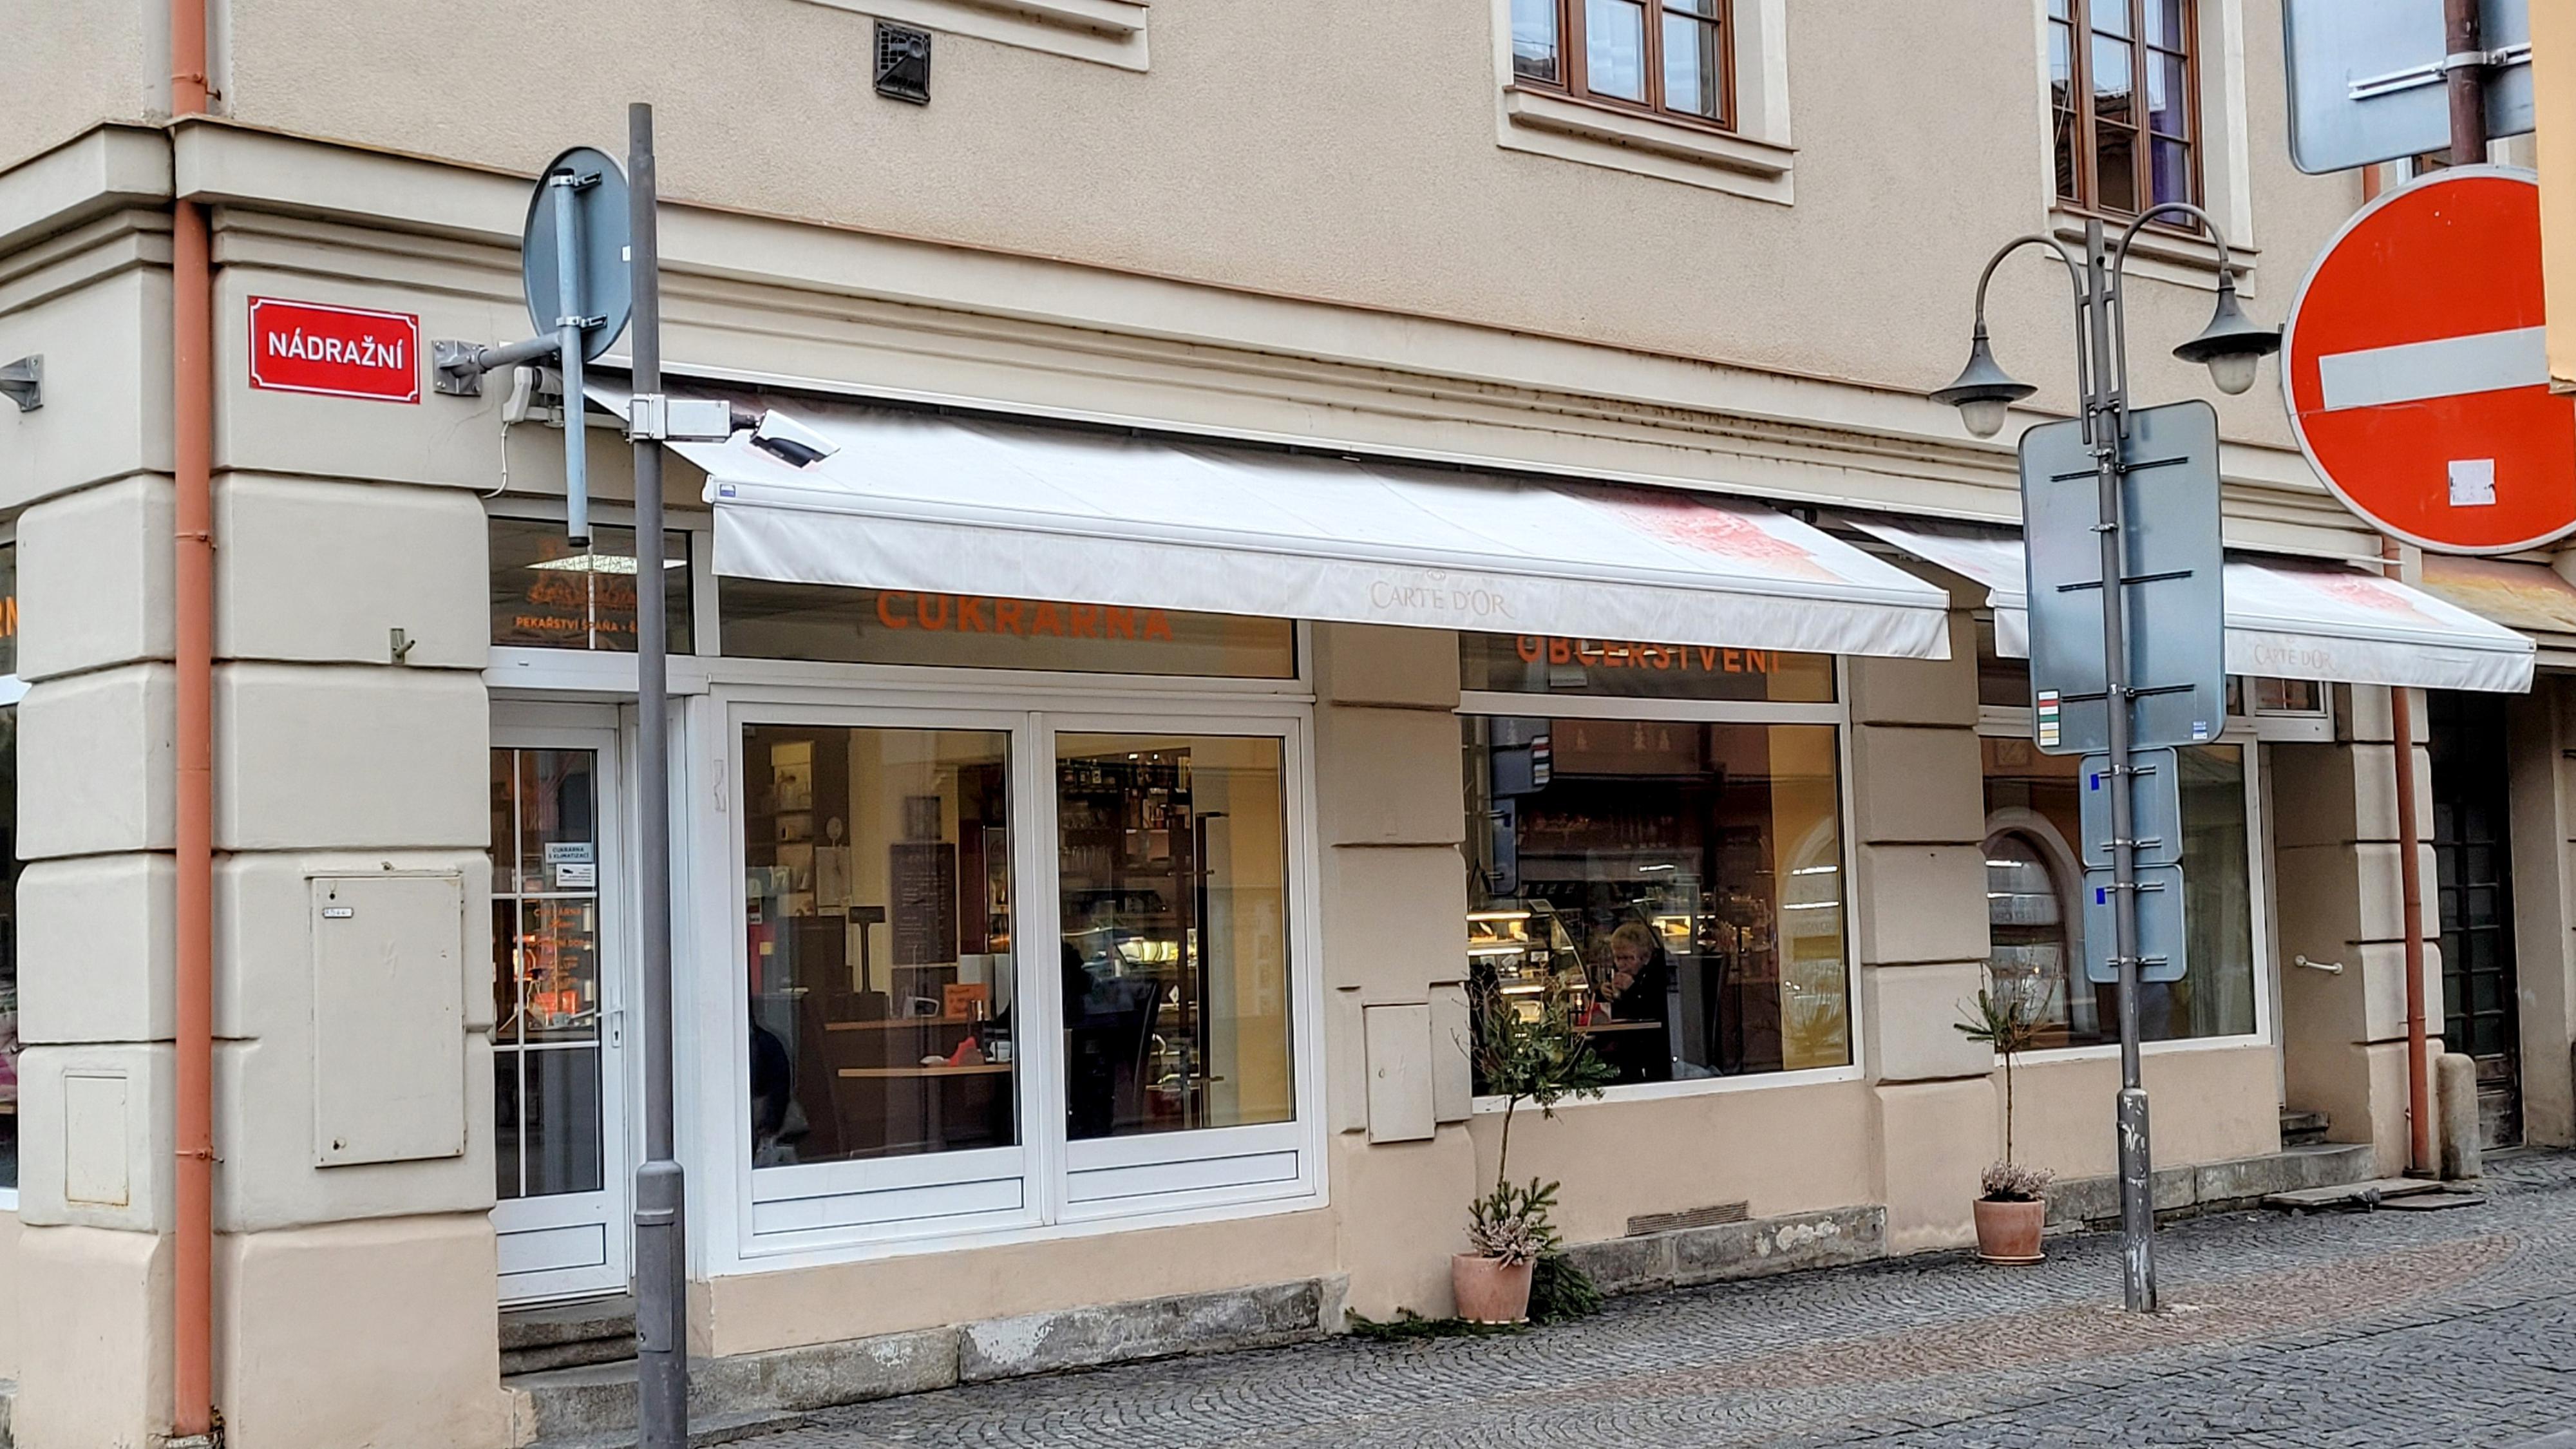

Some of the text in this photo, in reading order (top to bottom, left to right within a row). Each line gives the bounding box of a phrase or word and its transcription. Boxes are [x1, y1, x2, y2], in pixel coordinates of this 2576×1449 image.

[268, 327, 403, 370] NÁDRAŽNÍ
[1370, 581, 1515, 619] CARTE D'OR
